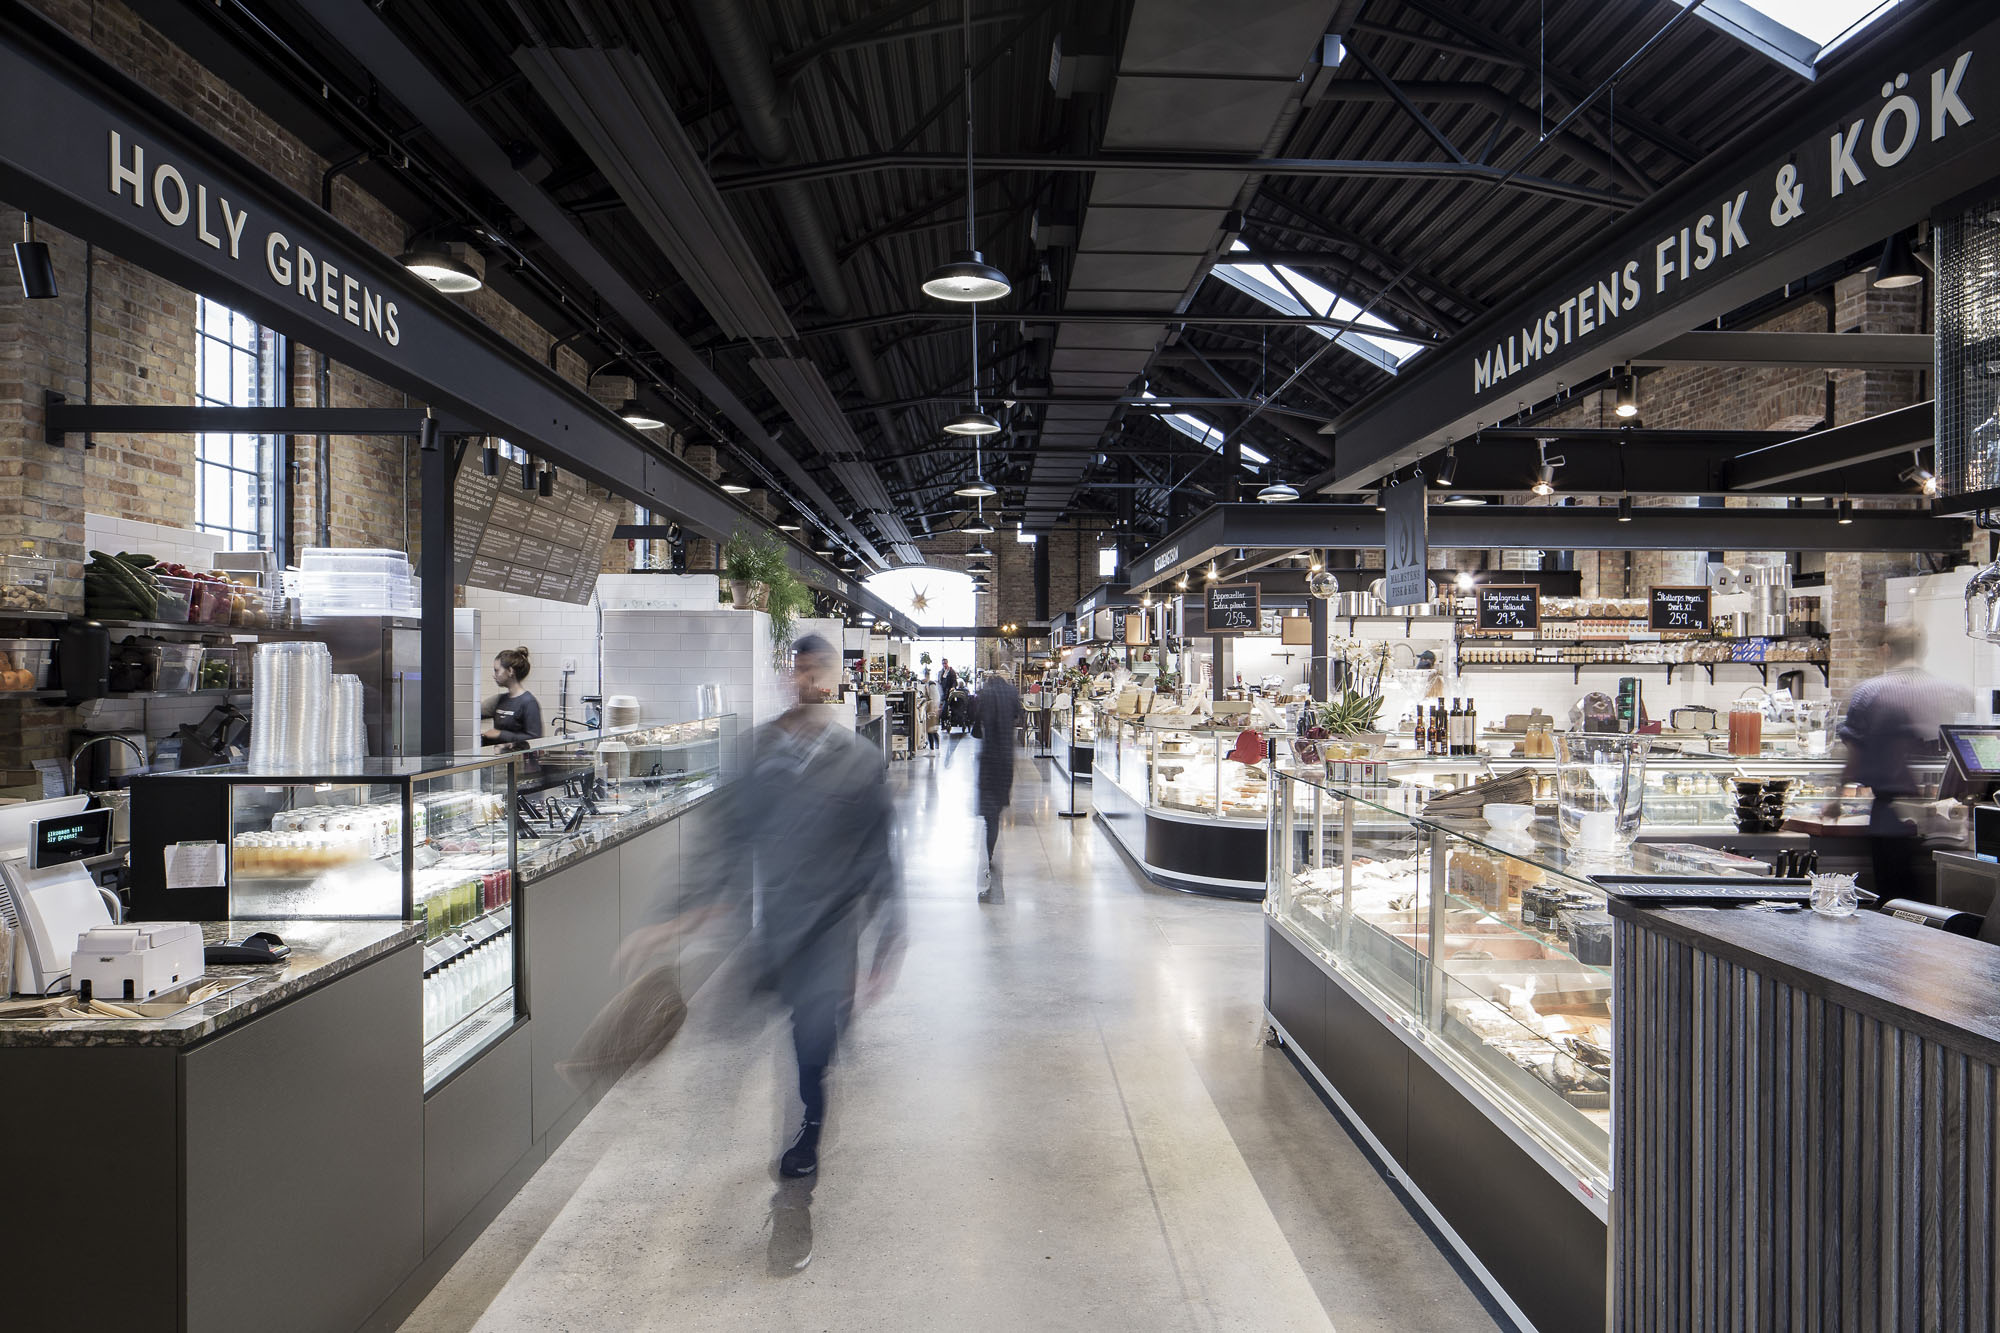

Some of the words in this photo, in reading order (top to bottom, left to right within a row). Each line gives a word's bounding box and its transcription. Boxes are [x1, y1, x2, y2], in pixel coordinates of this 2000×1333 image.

[109, 129, 248, 260] HOLY
[265, 230, 401, 348] GREENS
[1474, 260, 1641, 394] MALMSTENS
[1655, 190, 1750, 294] FISK
[1769, 163, 1805, 227] &
[1829, 50, 1975, 198] KÖK
